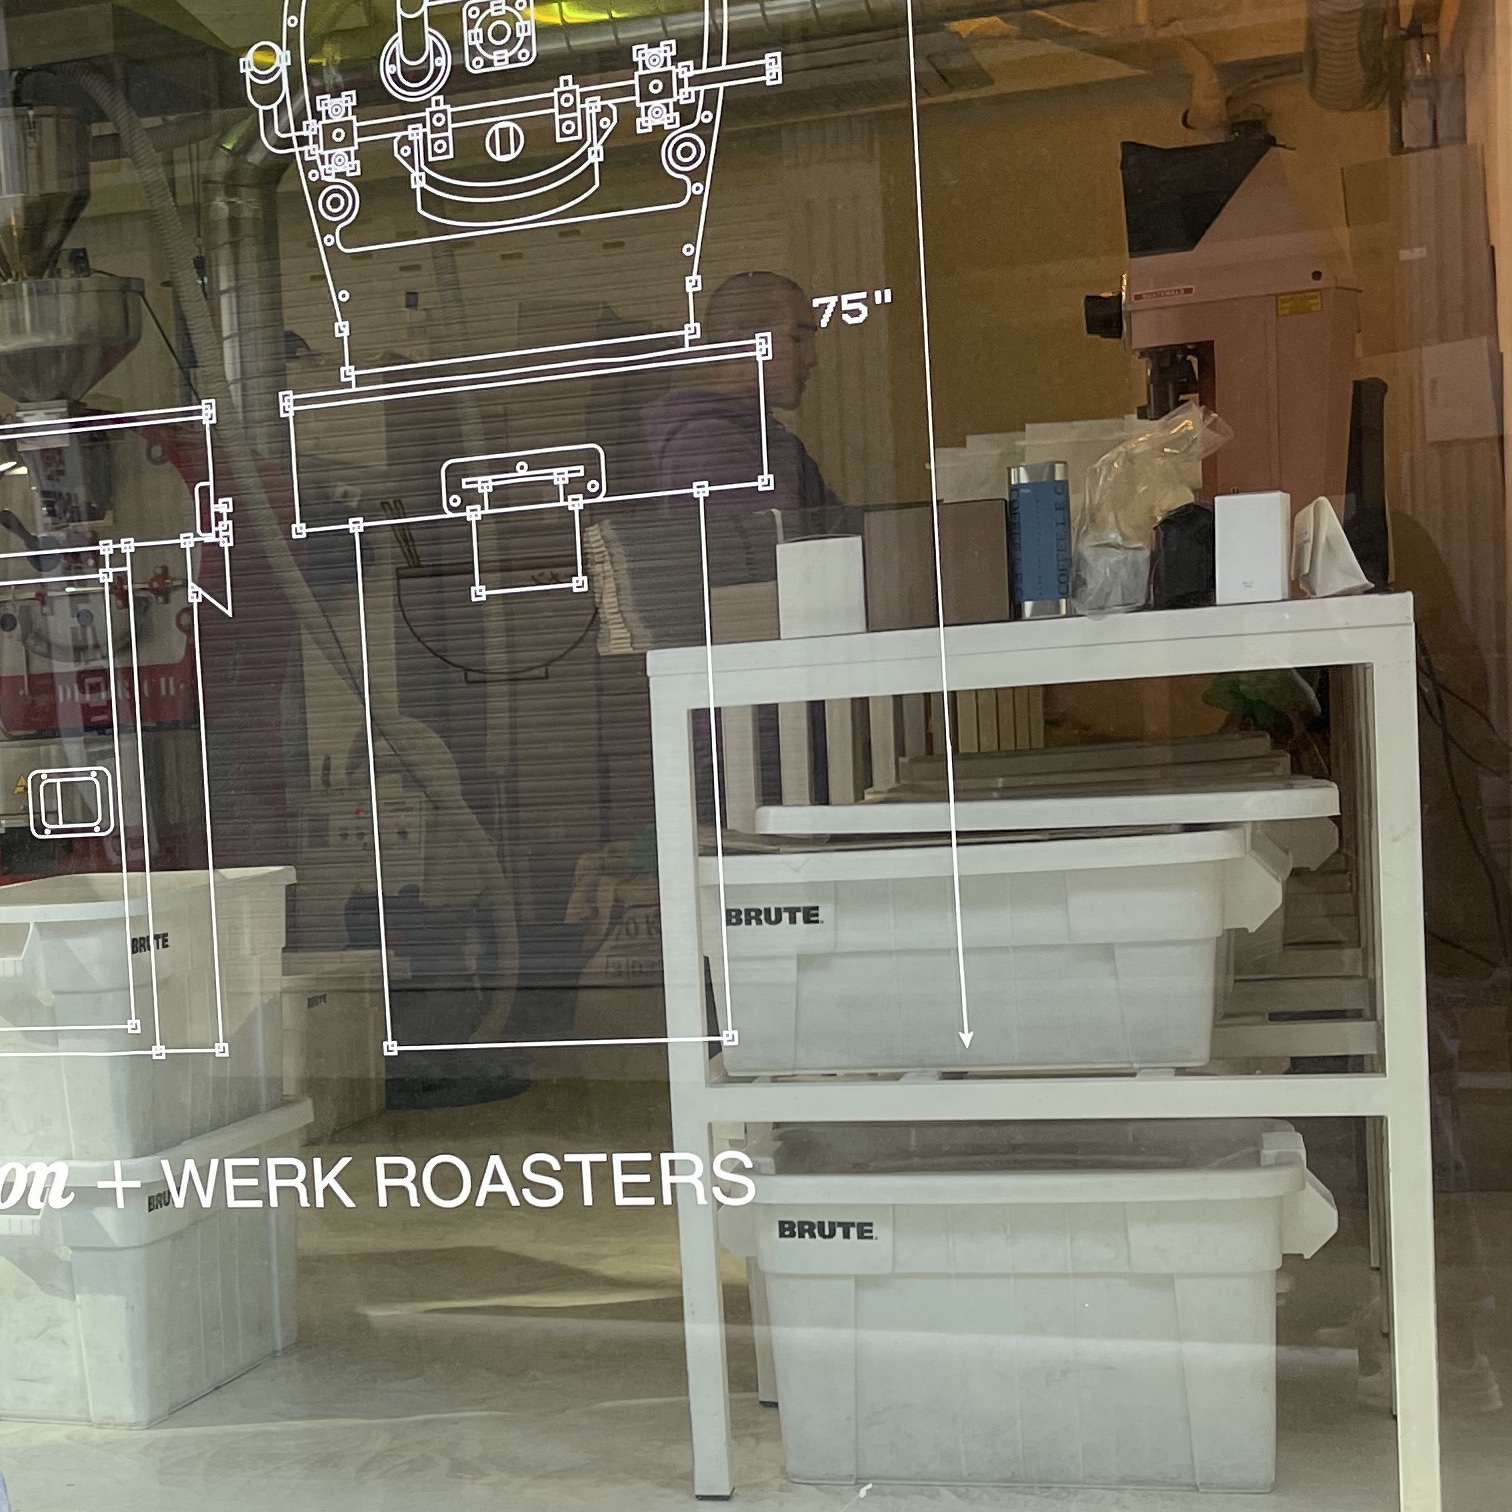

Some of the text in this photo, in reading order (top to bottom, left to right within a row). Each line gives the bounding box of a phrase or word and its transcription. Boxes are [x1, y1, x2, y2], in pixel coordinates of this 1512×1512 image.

[812, 288, 892, 328] 75"
[725, 905, 820, 926] BRUTE
[160, 1156, 356, 1209] WERK
[374, 1150, 757, 1208] ROASTERS
[778, 1219, 874, 1241] BRUTE
